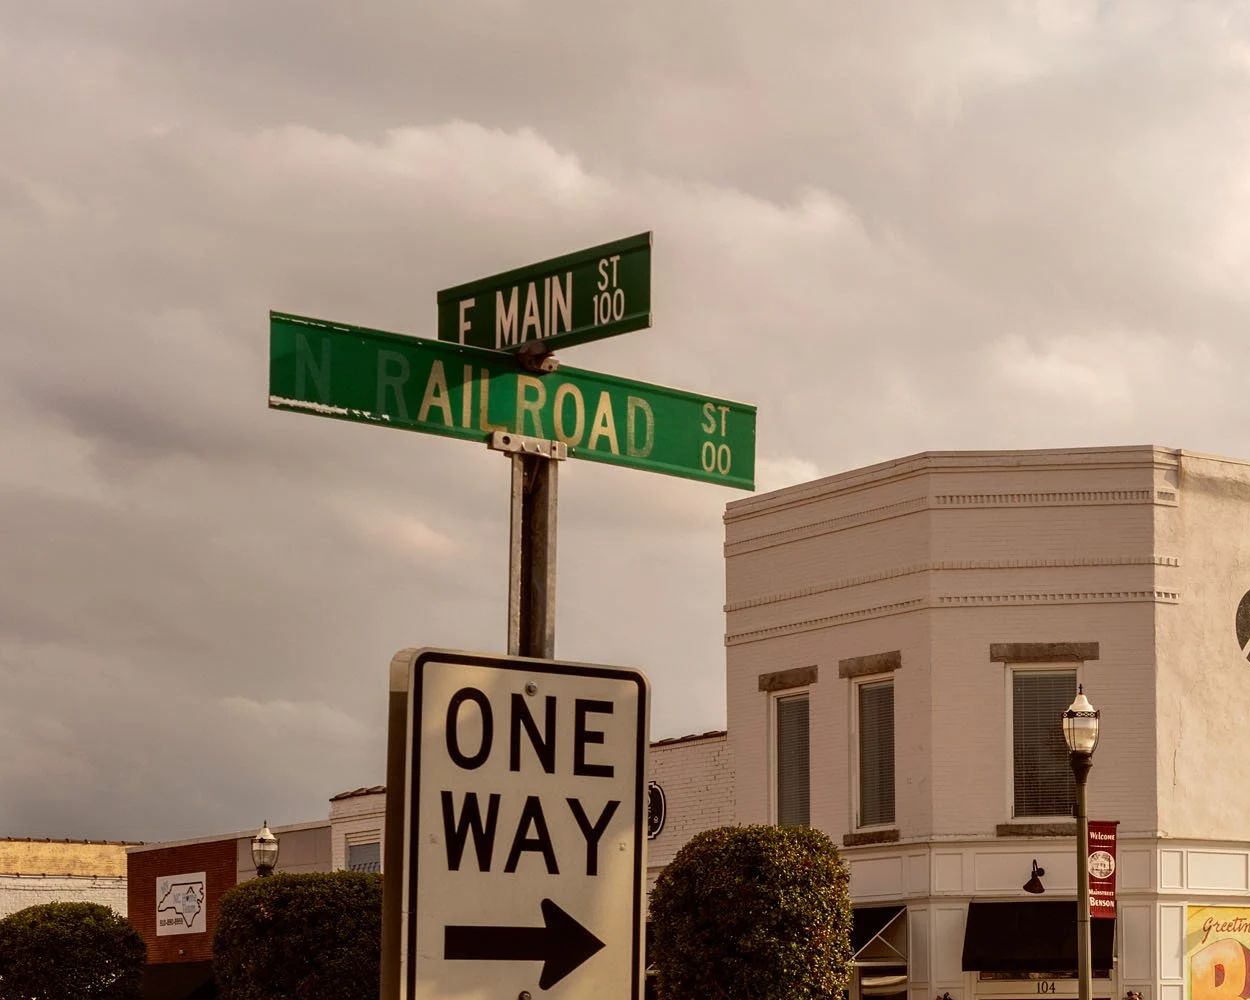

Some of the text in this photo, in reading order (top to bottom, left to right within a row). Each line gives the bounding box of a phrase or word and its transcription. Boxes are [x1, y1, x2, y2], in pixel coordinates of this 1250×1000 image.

[495, 271, 573, 349] MAIN
[598, 255, 620, 291] ST
[593, 288, 625, 326] 100
[295, 333, 730, 457] N RAILROAD ST
[702, 441, 732, 476] 00
[445, 687, 615, 778] ONE
[440, 790, 622, 876] WAY
[1036, 981, 1056, 994] 104
